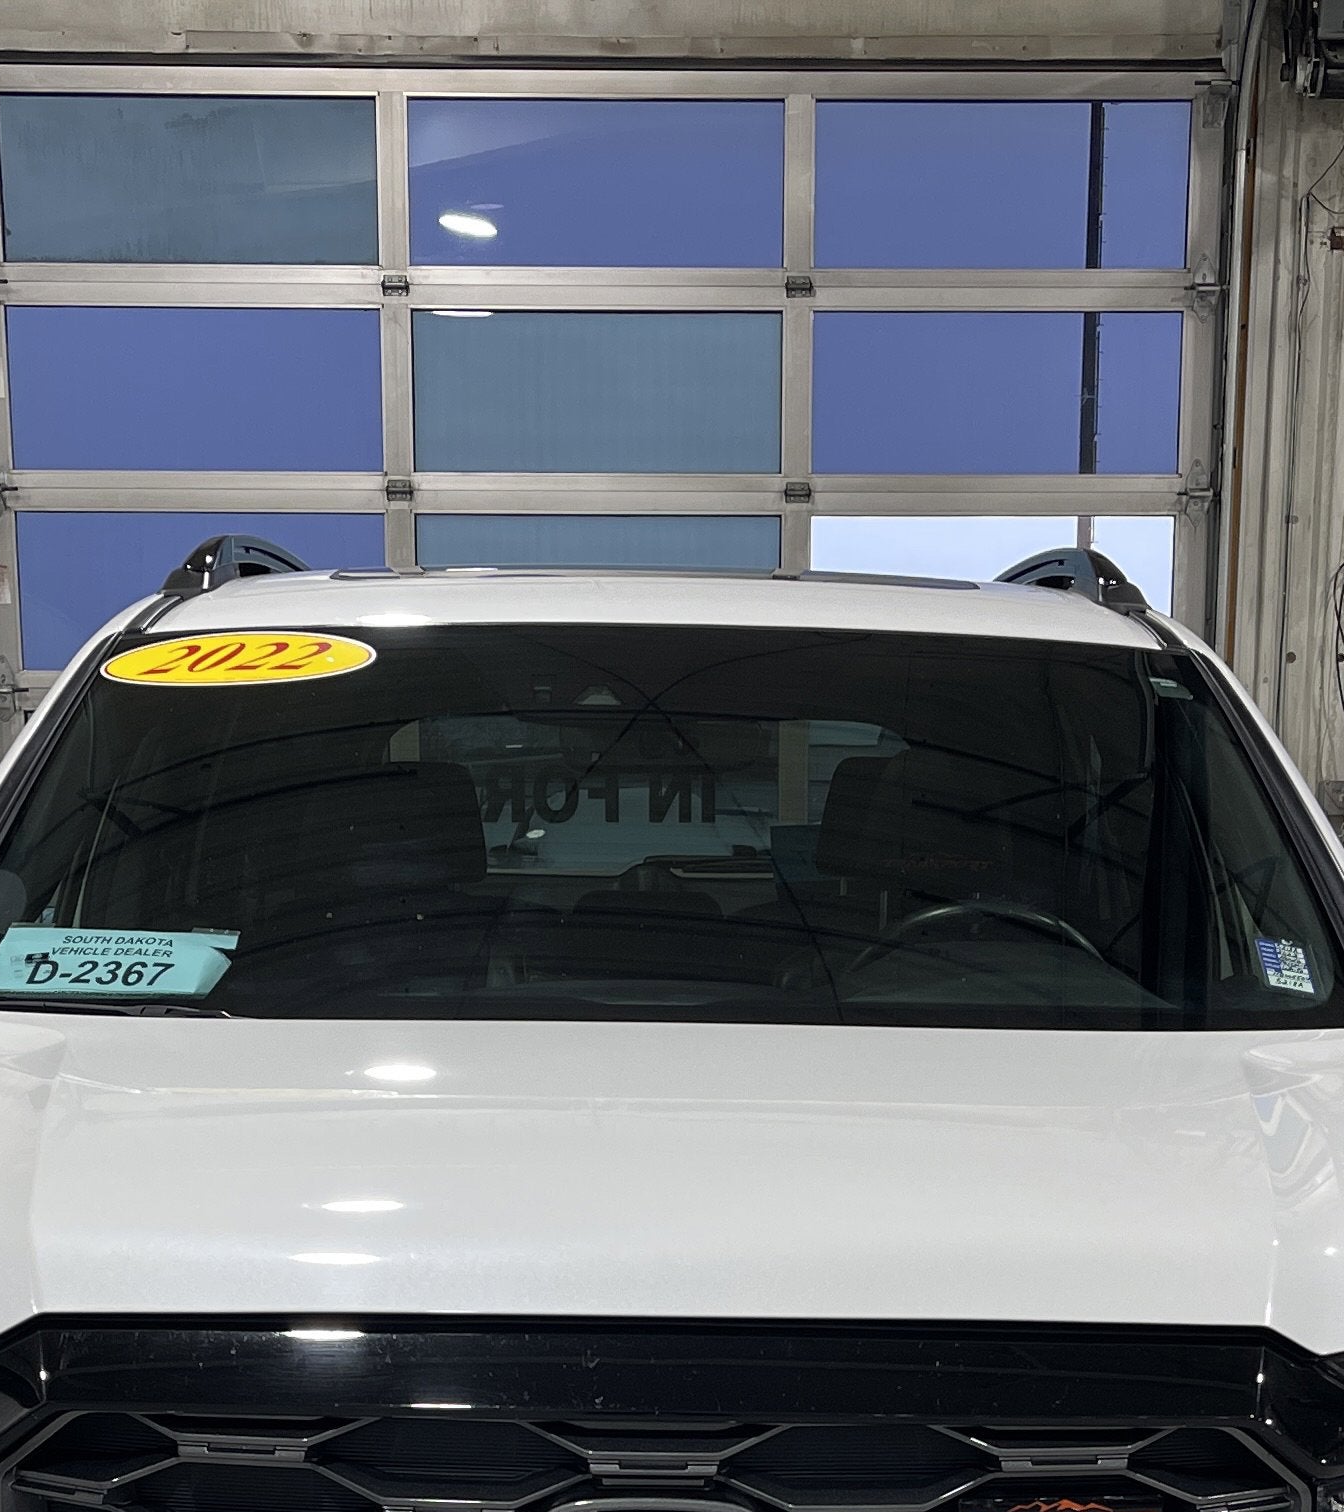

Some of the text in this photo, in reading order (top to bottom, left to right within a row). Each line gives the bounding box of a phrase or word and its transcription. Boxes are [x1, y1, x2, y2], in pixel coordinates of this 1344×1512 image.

[137, 641, 333, 676] 2022
[62, 935, 174, 948] SOUTH DAKOTA
[51, 946, 173, 958] VEHICLE DEALER
[25, 959, 175, 987] D-2367
